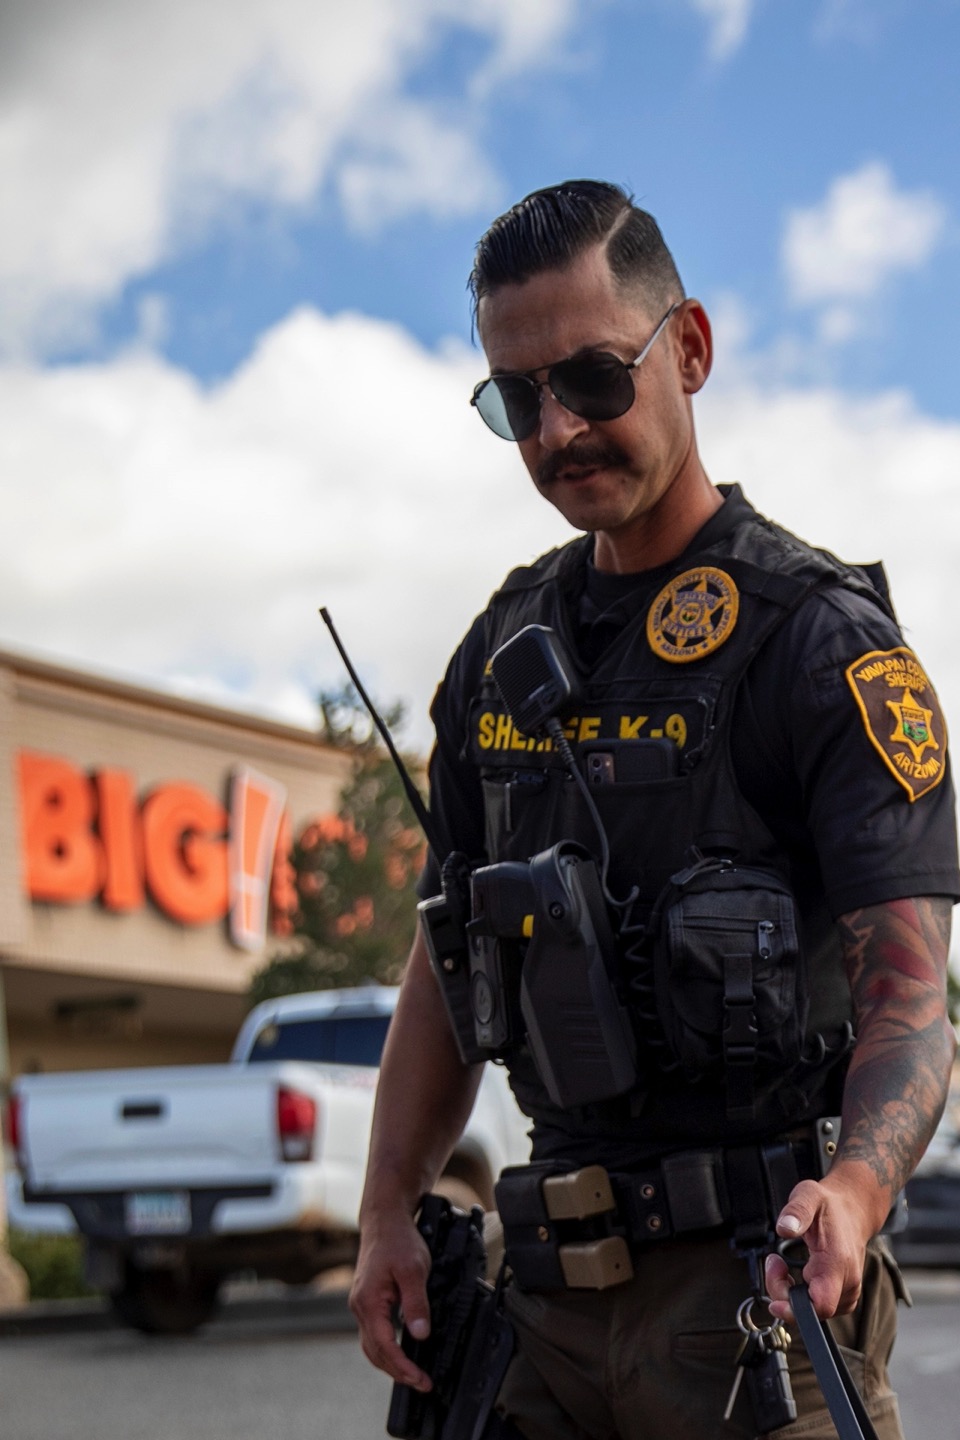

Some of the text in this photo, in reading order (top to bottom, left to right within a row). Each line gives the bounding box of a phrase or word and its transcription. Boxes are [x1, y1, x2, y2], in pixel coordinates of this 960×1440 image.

[855, 658, 906, 682] YAVAPAI
[885, 671, 926, 693] SHERIFF
[619, 713, 688, 750] K-9
[892, 752, 941, 779] ARIZONA
